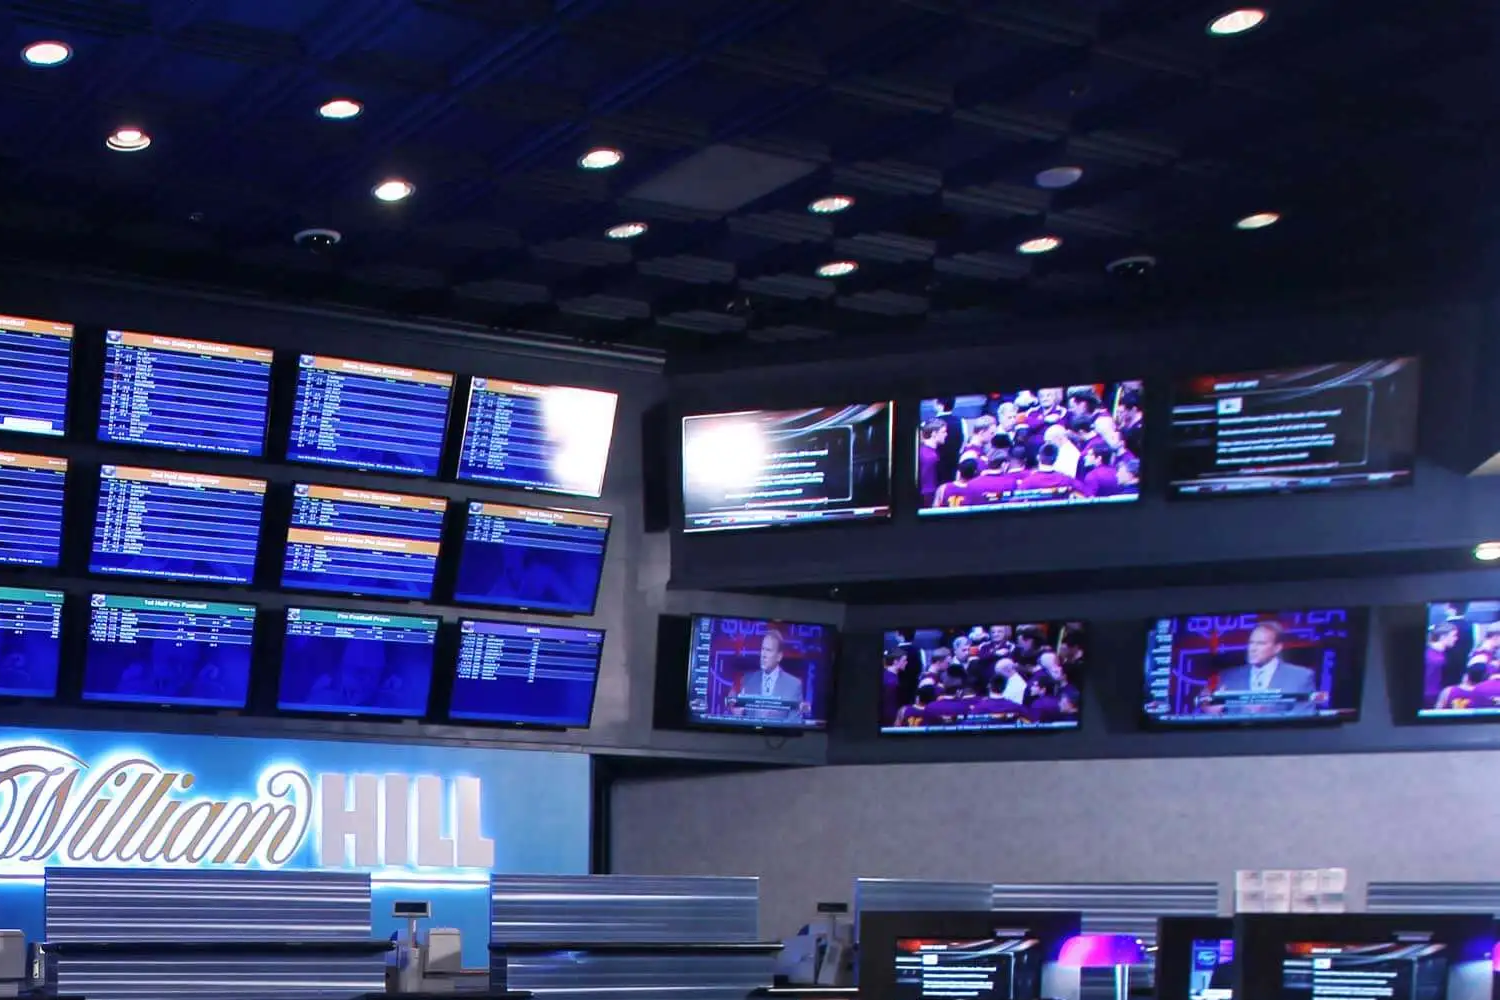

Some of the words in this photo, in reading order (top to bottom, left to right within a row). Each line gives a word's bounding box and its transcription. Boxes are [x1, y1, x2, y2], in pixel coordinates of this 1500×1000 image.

[155, 600, 168, 608] Half
[182, 602, 207, 610] Football
[350, 614, 372, 622] Football
[322, 774, 495, 867] HILL
